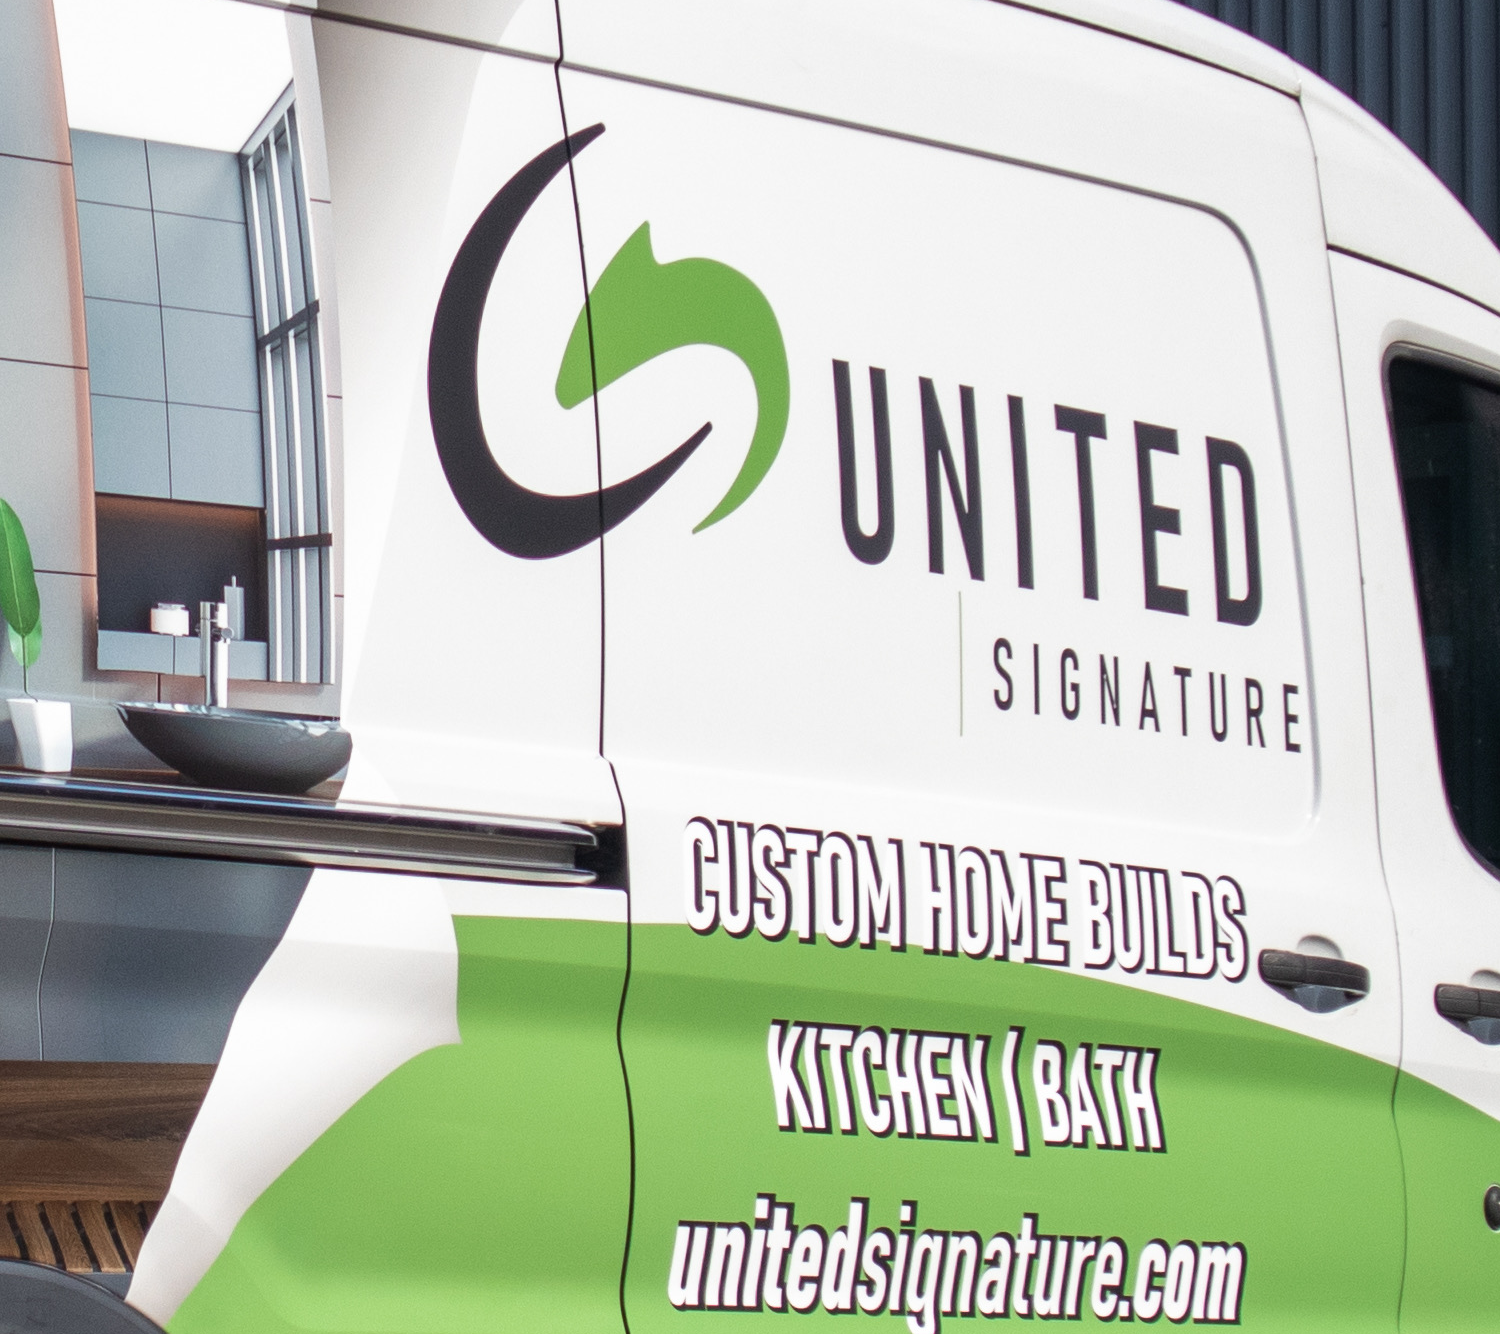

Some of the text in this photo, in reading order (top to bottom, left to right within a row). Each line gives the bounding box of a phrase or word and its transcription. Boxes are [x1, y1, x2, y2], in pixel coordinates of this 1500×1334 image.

[831, 357, 1265, 628] UNITED
[993, 637, 1304, 755] SIGNATURE
[682, 815, 1249, 982] CUSTOM HOME BUILDS
[766, 1019, 994, 1145] KITCHEN
[1033, 1037, 1168, 1153] BATH
